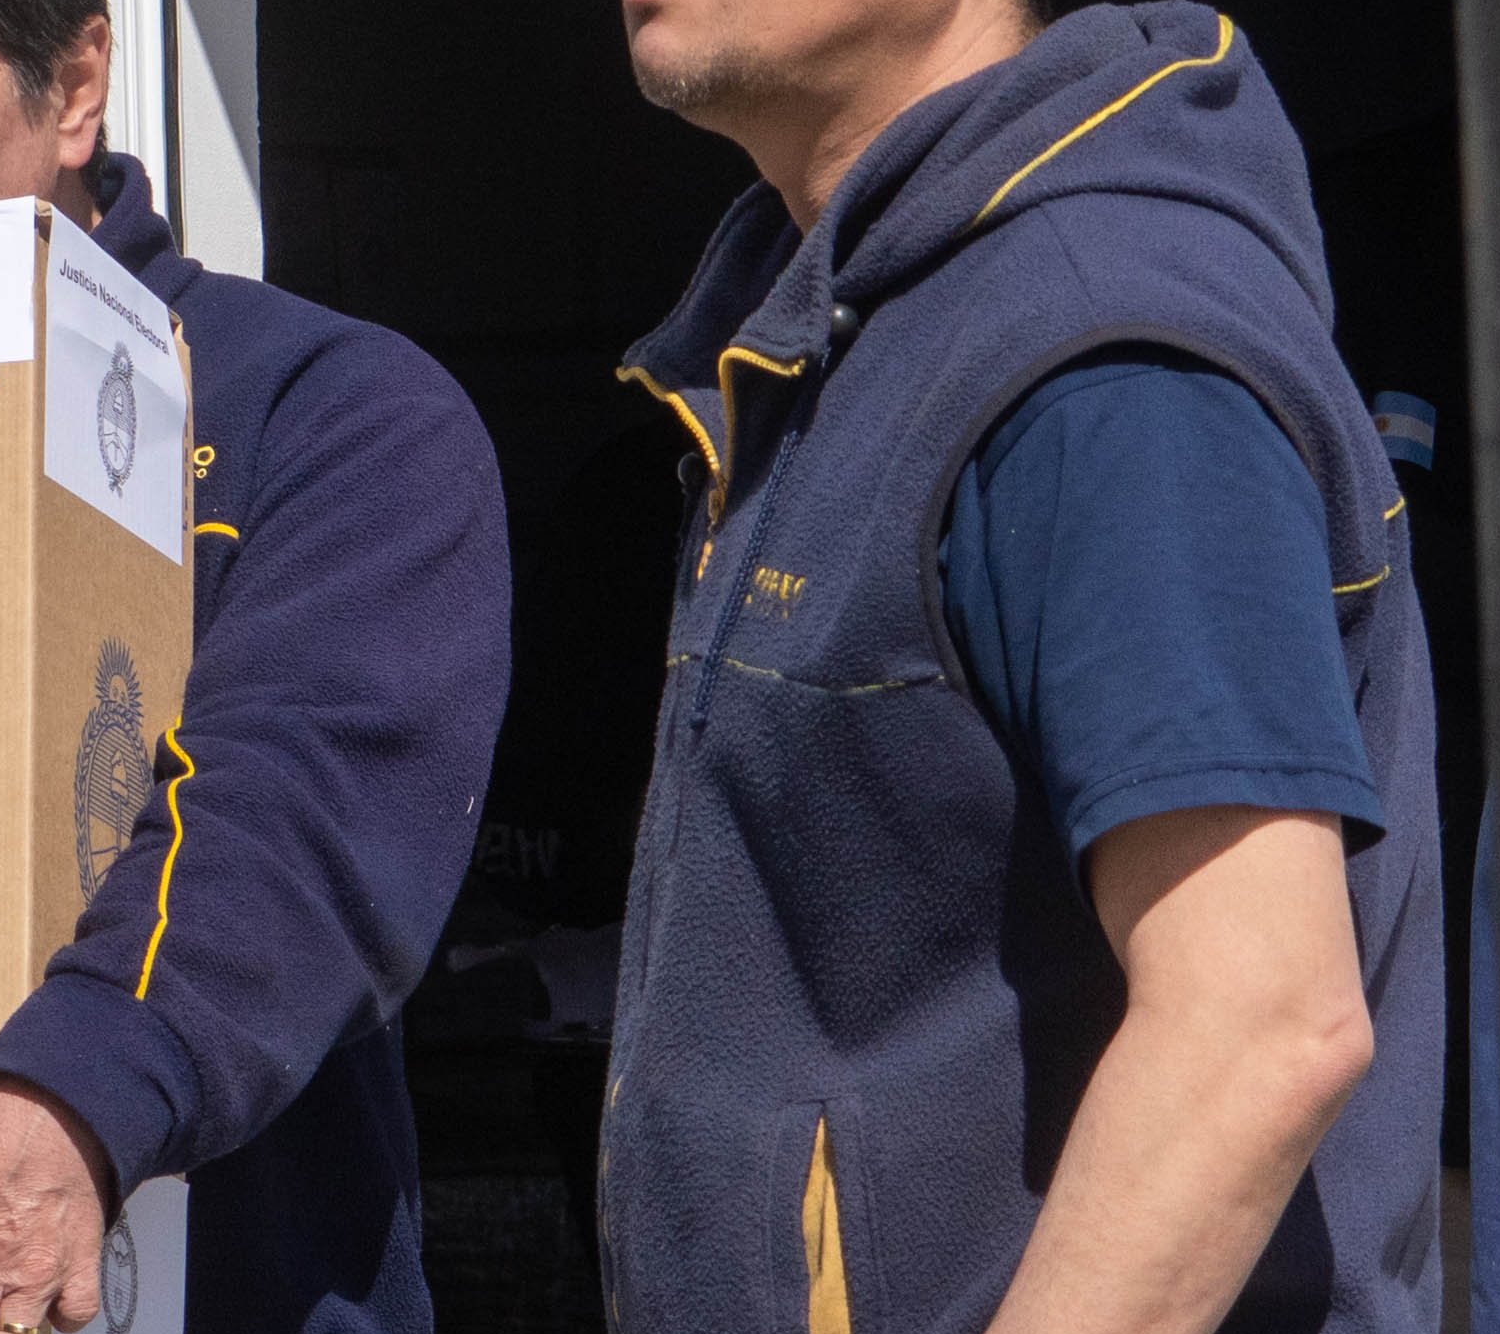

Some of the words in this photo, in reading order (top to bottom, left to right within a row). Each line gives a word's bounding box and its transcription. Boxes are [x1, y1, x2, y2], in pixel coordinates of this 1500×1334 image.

[59, 259, 98, 297] Justicia
[99, 282, 135, 327] Nacional
[133, 314, 170, 356] Electoral
